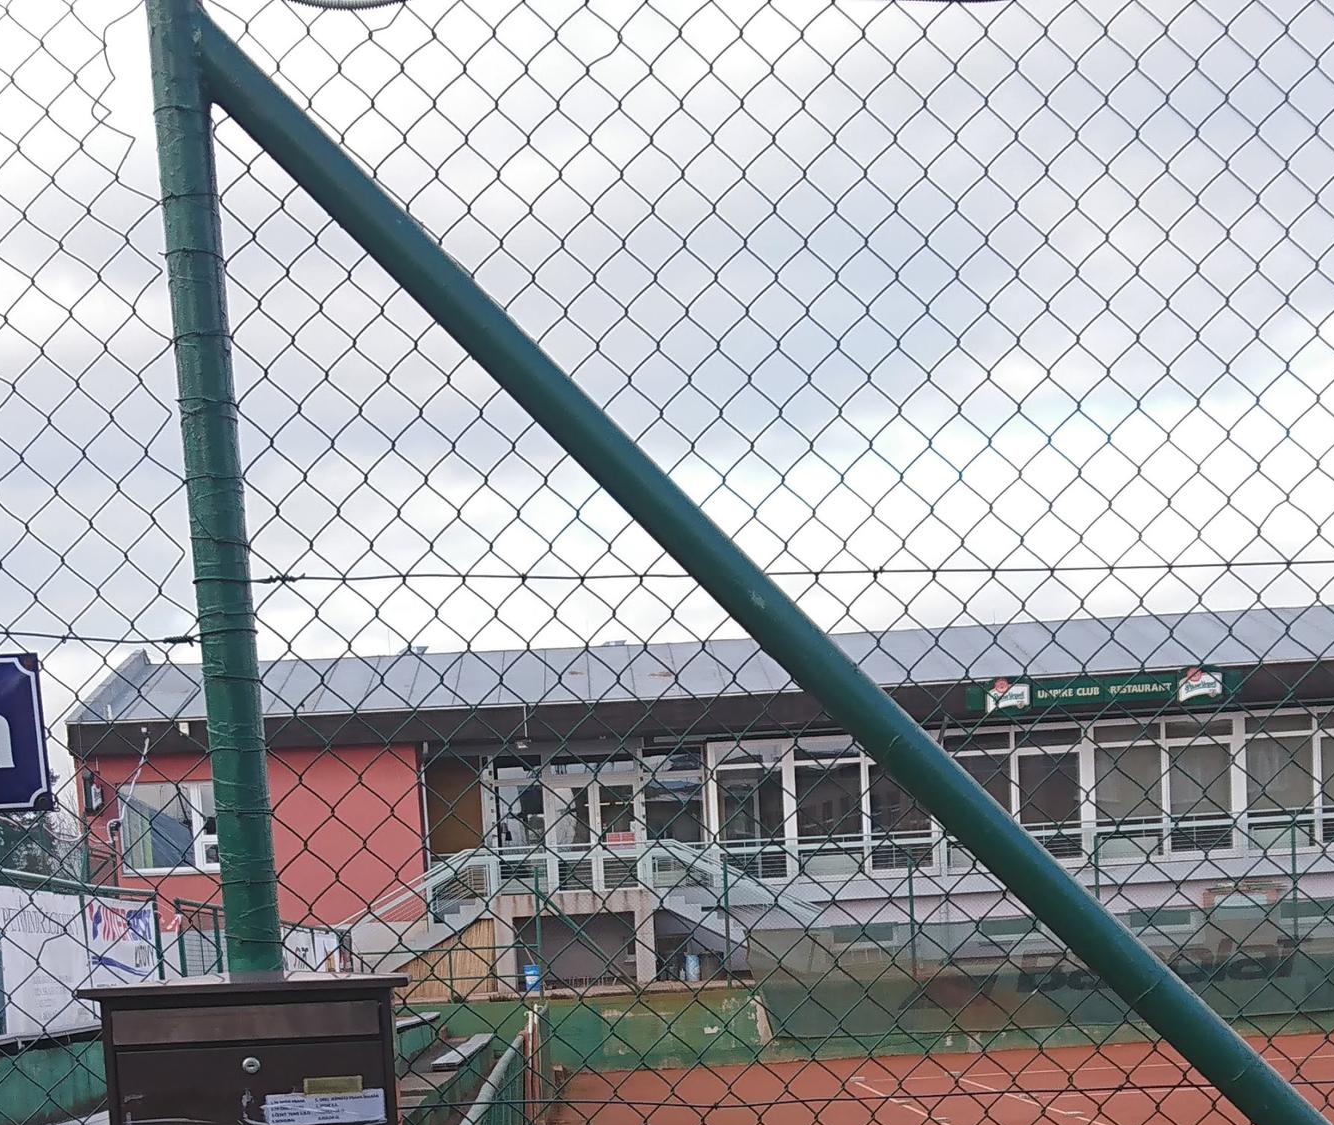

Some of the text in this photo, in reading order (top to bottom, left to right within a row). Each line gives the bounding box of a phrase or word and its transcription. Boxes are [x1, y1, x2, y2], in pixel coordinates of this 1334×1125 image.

[1037, 682, 1173, 699] UMPIRE CLUB RESTAURANT
